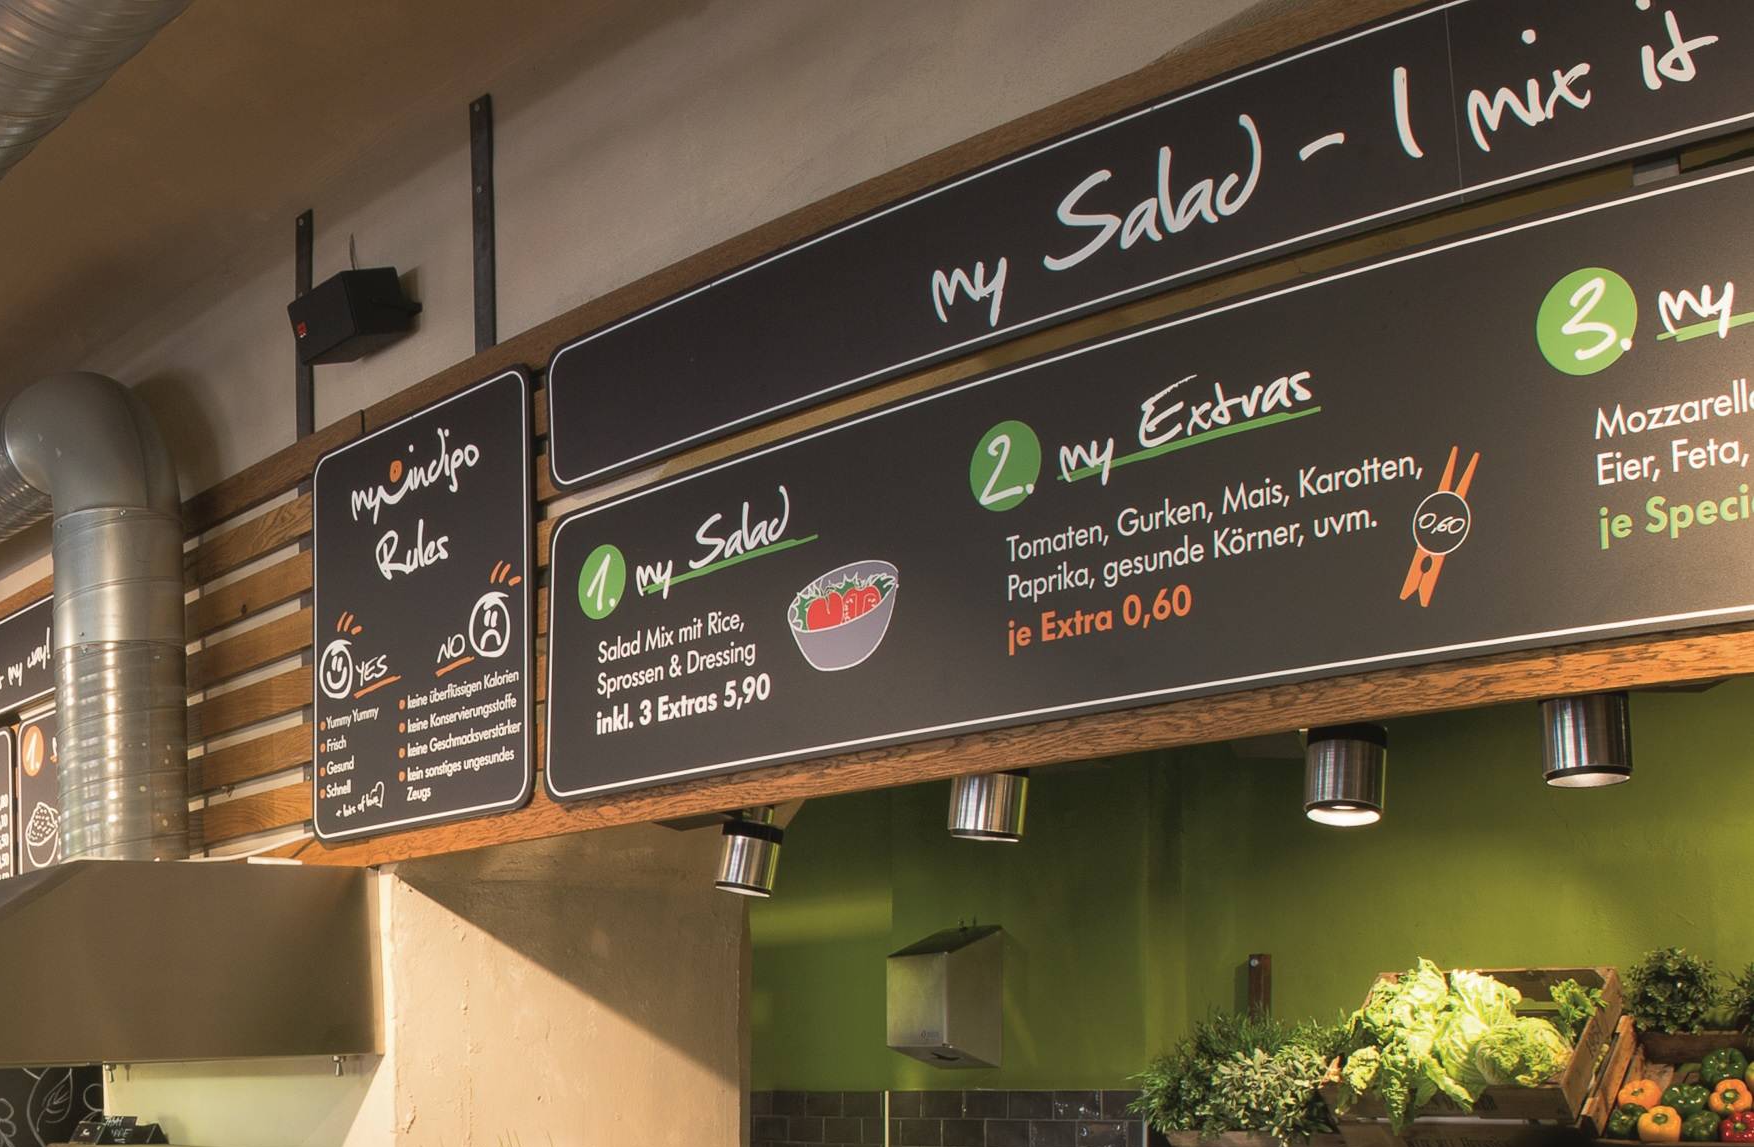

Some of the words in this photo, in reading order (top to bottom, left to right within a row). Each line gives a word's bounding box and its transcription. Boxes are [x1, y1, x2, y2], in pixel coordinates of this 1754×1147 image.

[931, 257, 1007, 328] my
[1043, 114, 1262, 272] Salad
[1467, 29, 1591, 152] mix
[1635, 0, 1719, 90] it
[1657, 281, 1734, 339] my
[1058, 436, 1115, 486] my
[1137, 371, 1313, 448] Extras
[1596, 451, 1661, 486] Eier,
[1670, 438, 1751, 473] Feta,
[1006, 521, 1109, 563] Tomaten,
[1117, 498, 1214, 540] Gurken,
[1221, 477, 1290, 515] Mais,
[1298, 453, 1424, 499] Karotten,
[1599, 506, 1633, 550] je
[1645, 483, 1754, 539] Speci
[375, 518, 449, 581] Rules
[636, 559, 673, 600] my
[688, 485, 790, 569] Salad
[1007, 565, 1096, 603] Paprika,
[1103, 536, 1205, 588] gesunde
[1213, 519, 1306, 559] Körner,
[1314, 505, 1379, 539] uvm.
[597, 630, 641, 664] Salad
[645, 625, 674, 652] Mix
[678, 618, 703, 643] mit
[707, 611, 745, 636] Rice,
[1007, 620, 1032, 656] je
[1041, 600, 1113, 643] Extra
[1122, 584, 1192, 629] 0,60
[8, 662, 23, 687] my
[26, 626, 51, 670] way!
[355, 654, 389, 687] YES
[436, 633, 466, 664] NO
[596, 664, 664, 699] Sprossen
[668, 654, 682, 678] &
[686, 642, 756, 674] Dressing
[407, 694, 428, 710] keine
[429, 680, 482, 704] überflüssigen
[483, 669, 520, 688] Kalorien
[407, 718, 428, 734] keine
[430, 693, 517, 727] Konservierungsstoffe
[596, 702, 634, 736] inkl.
[639, 698, 652, 726] 3
[657, 690, 718, 722] Extras
[723, 673, 771, 710] 5,90
[326, 712, 352, 731] Yummy
[352, 706, 379, 723] Yummy
[326, 735, 347, 753] Frisch
[407, 742, 428, 758] keine
[429, 721, 522, 752] Geschmacksverstärker
[326, 756, 355, 775] Gesund
[326, 779, 351, 799] Schnell
[407, 767, 423, 782] kein
[425, 758, 462, 777] sonstiges
[463, 745, 515, 770] ungesundes
[406, 785, 432, 802] Zeugs
